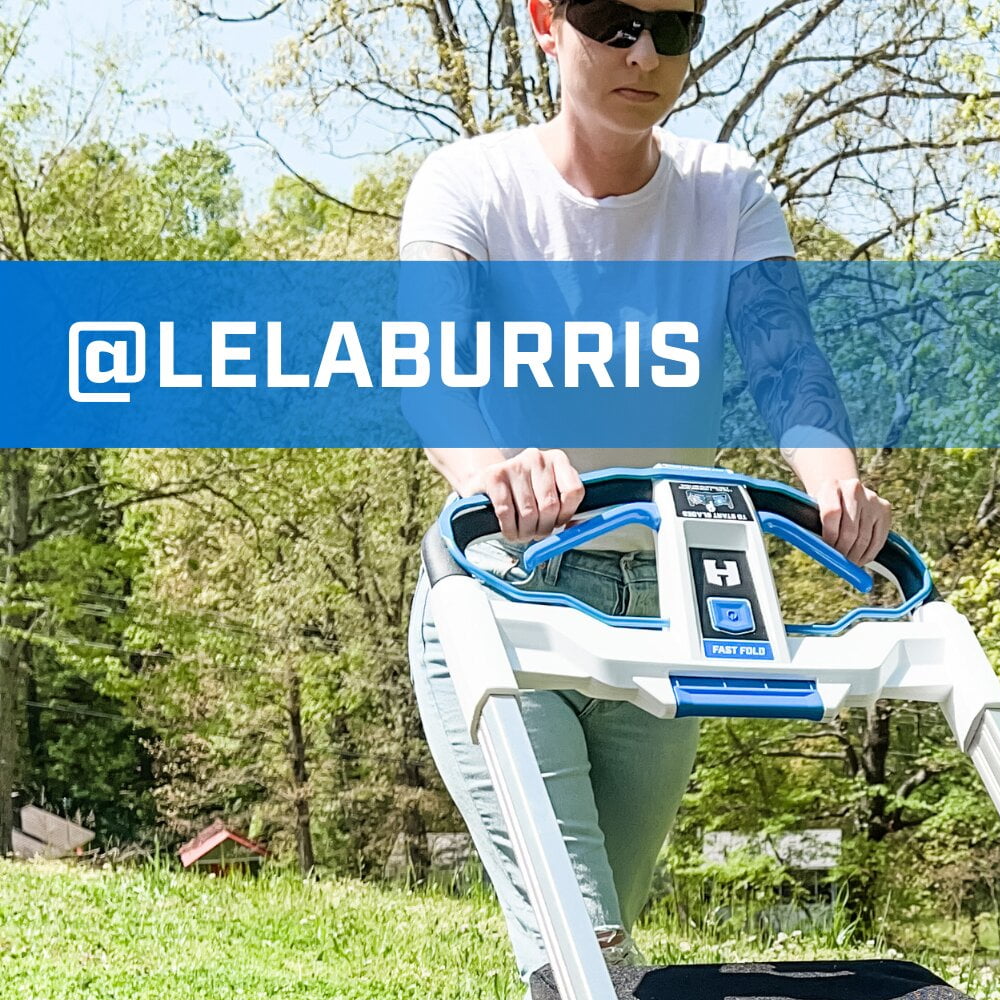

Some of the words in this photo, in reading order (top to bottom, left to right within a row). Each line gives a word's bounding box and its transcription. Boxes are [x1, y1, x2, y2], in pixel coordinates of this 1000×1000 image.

[703, 559, 742, 587] H
[712, 644, 738, 655] FAST
[739, 645, 766, 656] FOLD
